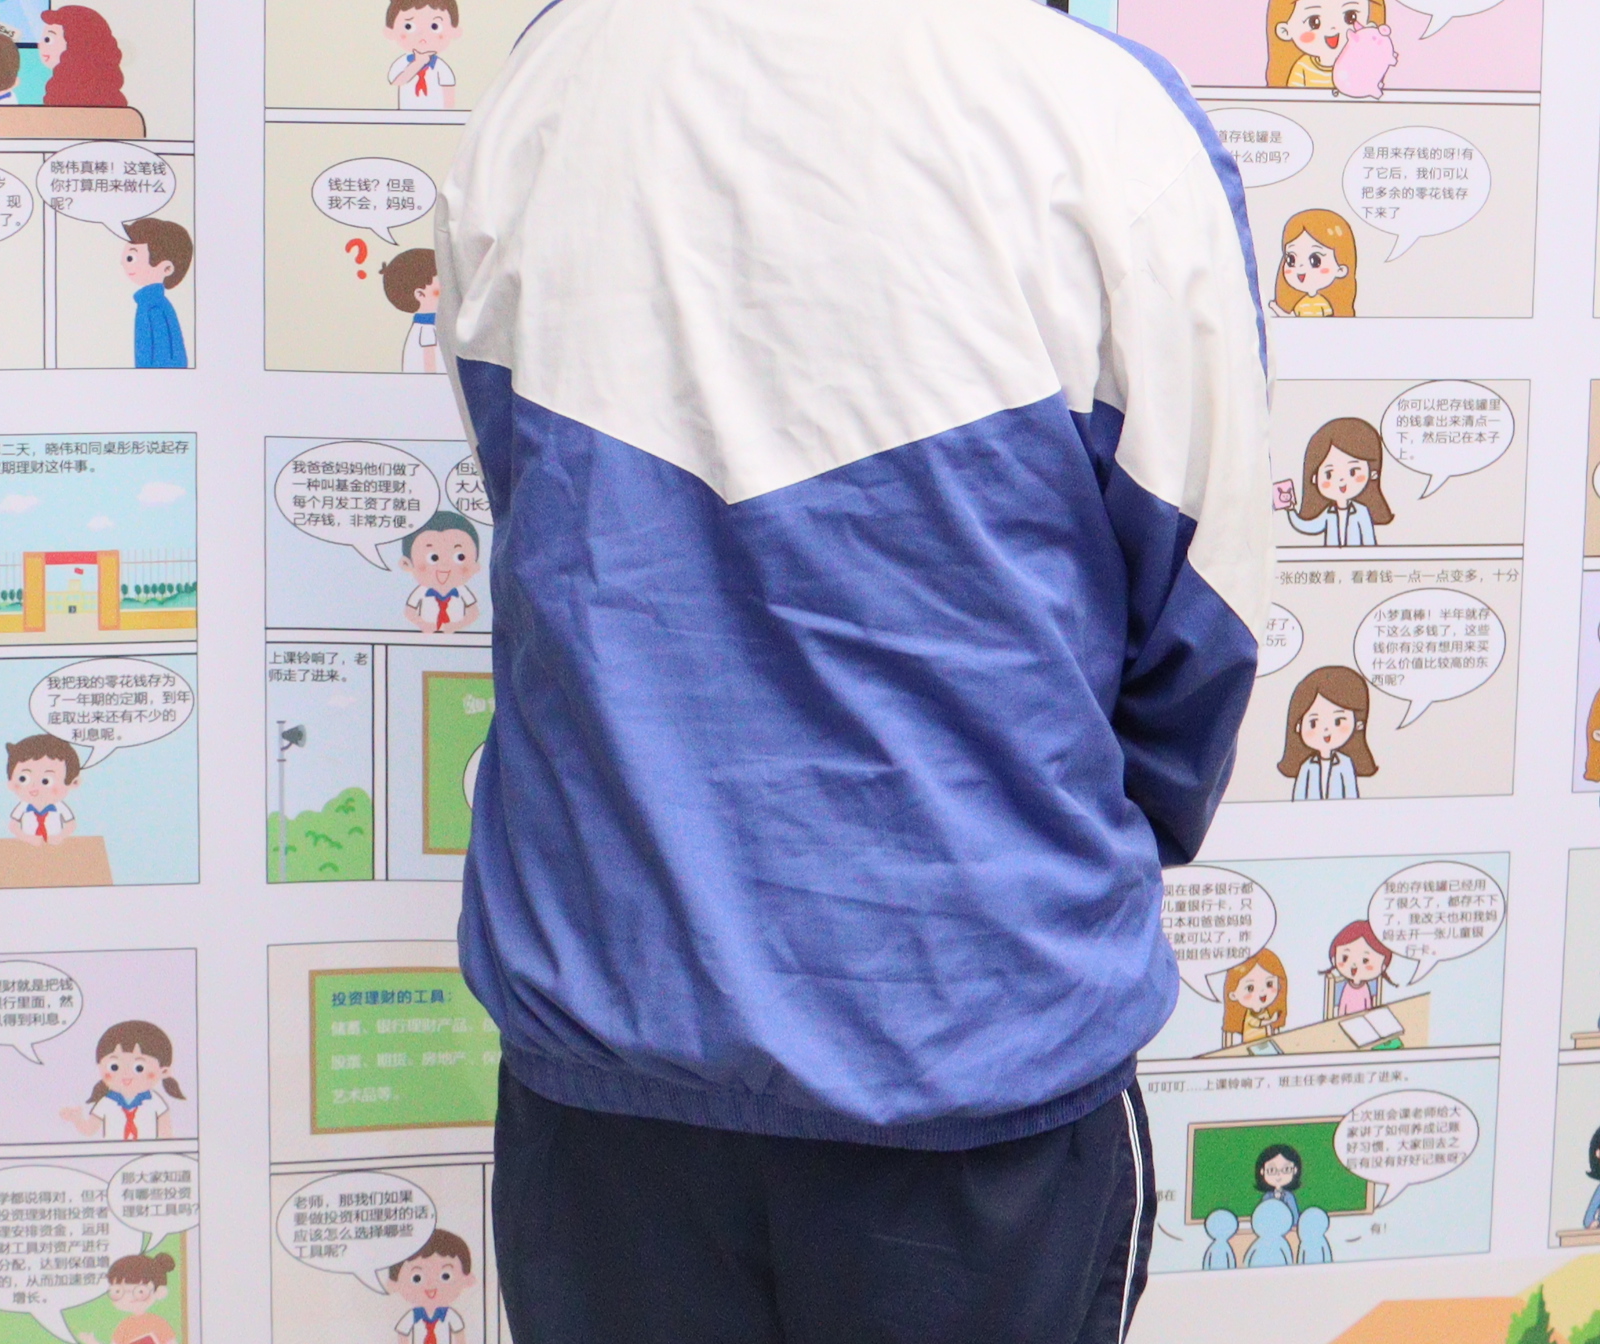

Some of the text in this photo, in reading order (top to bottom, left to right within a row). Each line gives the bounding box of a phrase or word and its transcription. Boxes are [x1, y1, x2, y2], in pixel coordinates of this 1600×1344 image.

[1362, 146, 1474, 161] 是用来存钱的呀！有
[50, 160, 167, 177] 晓伟真棒！这笔钱
[1362, 167, 1469, 181] 了它后，我们可以
[50, 178, 167, 194] 你打算用来做什么
[327, 178, 416, 193] 钱生钱？但是
[1361, 187, 1468, 201] 把多余的零花钱存
[50, 196, 74, 211] 呢？
[327, 196, 423, 211] 我不会，妈妈。
[1361, 206, 1400, 220] 下来了
[1396, 398, 1502, 412] 你可以把存钱罐里
[1396, 415, 1501, 428] 的钱拿出来清点一
[1396, 431, 1501, 444] 下，然后记在本子
[1396, 447, 1416, 461] 上。
[292, 460, 421, 476] 我爸爸妈妈他们做了
[292, 478, 413, 494] 一种叫基金的理财，
[292, 496, 421, 512] 每个月发工资了就自
[293, 513, 415, 528] 己存钱，非常方便。
[1275, 568, 1520, 585] 张的数着，看着钱一点一点变多，十分
[1373, 607, 1491, 622] 小梦真棒！半年就存
[1373, 624, 1491, 638] 下这么多钱了，这些
[1372, 640, 1490, 654] 钱你有没有想用来买
[268, 651, 368, 665] 上课铃响了，老
[1371, 656, 1489, 670] 什么价值比较高的东
[47, 674, 176, 690] 我把我的零花钱存为
[268, 668, 348, 683] 师走了进来。
[1371, 673, 1405, 687] 西呢？
[47, 691, 191, 707] 了一年期的定期，到年
[47, 709, 177, 724] 底取出来还有不少的
[72, 727, 124, 742] 利息呢。
[1383, 878, 1487, 894] 我的存钱罐已经用
[1166, 930, 1252, 946] 就可以了，昨
[1405, 944, 1437, 958] 行卡。
